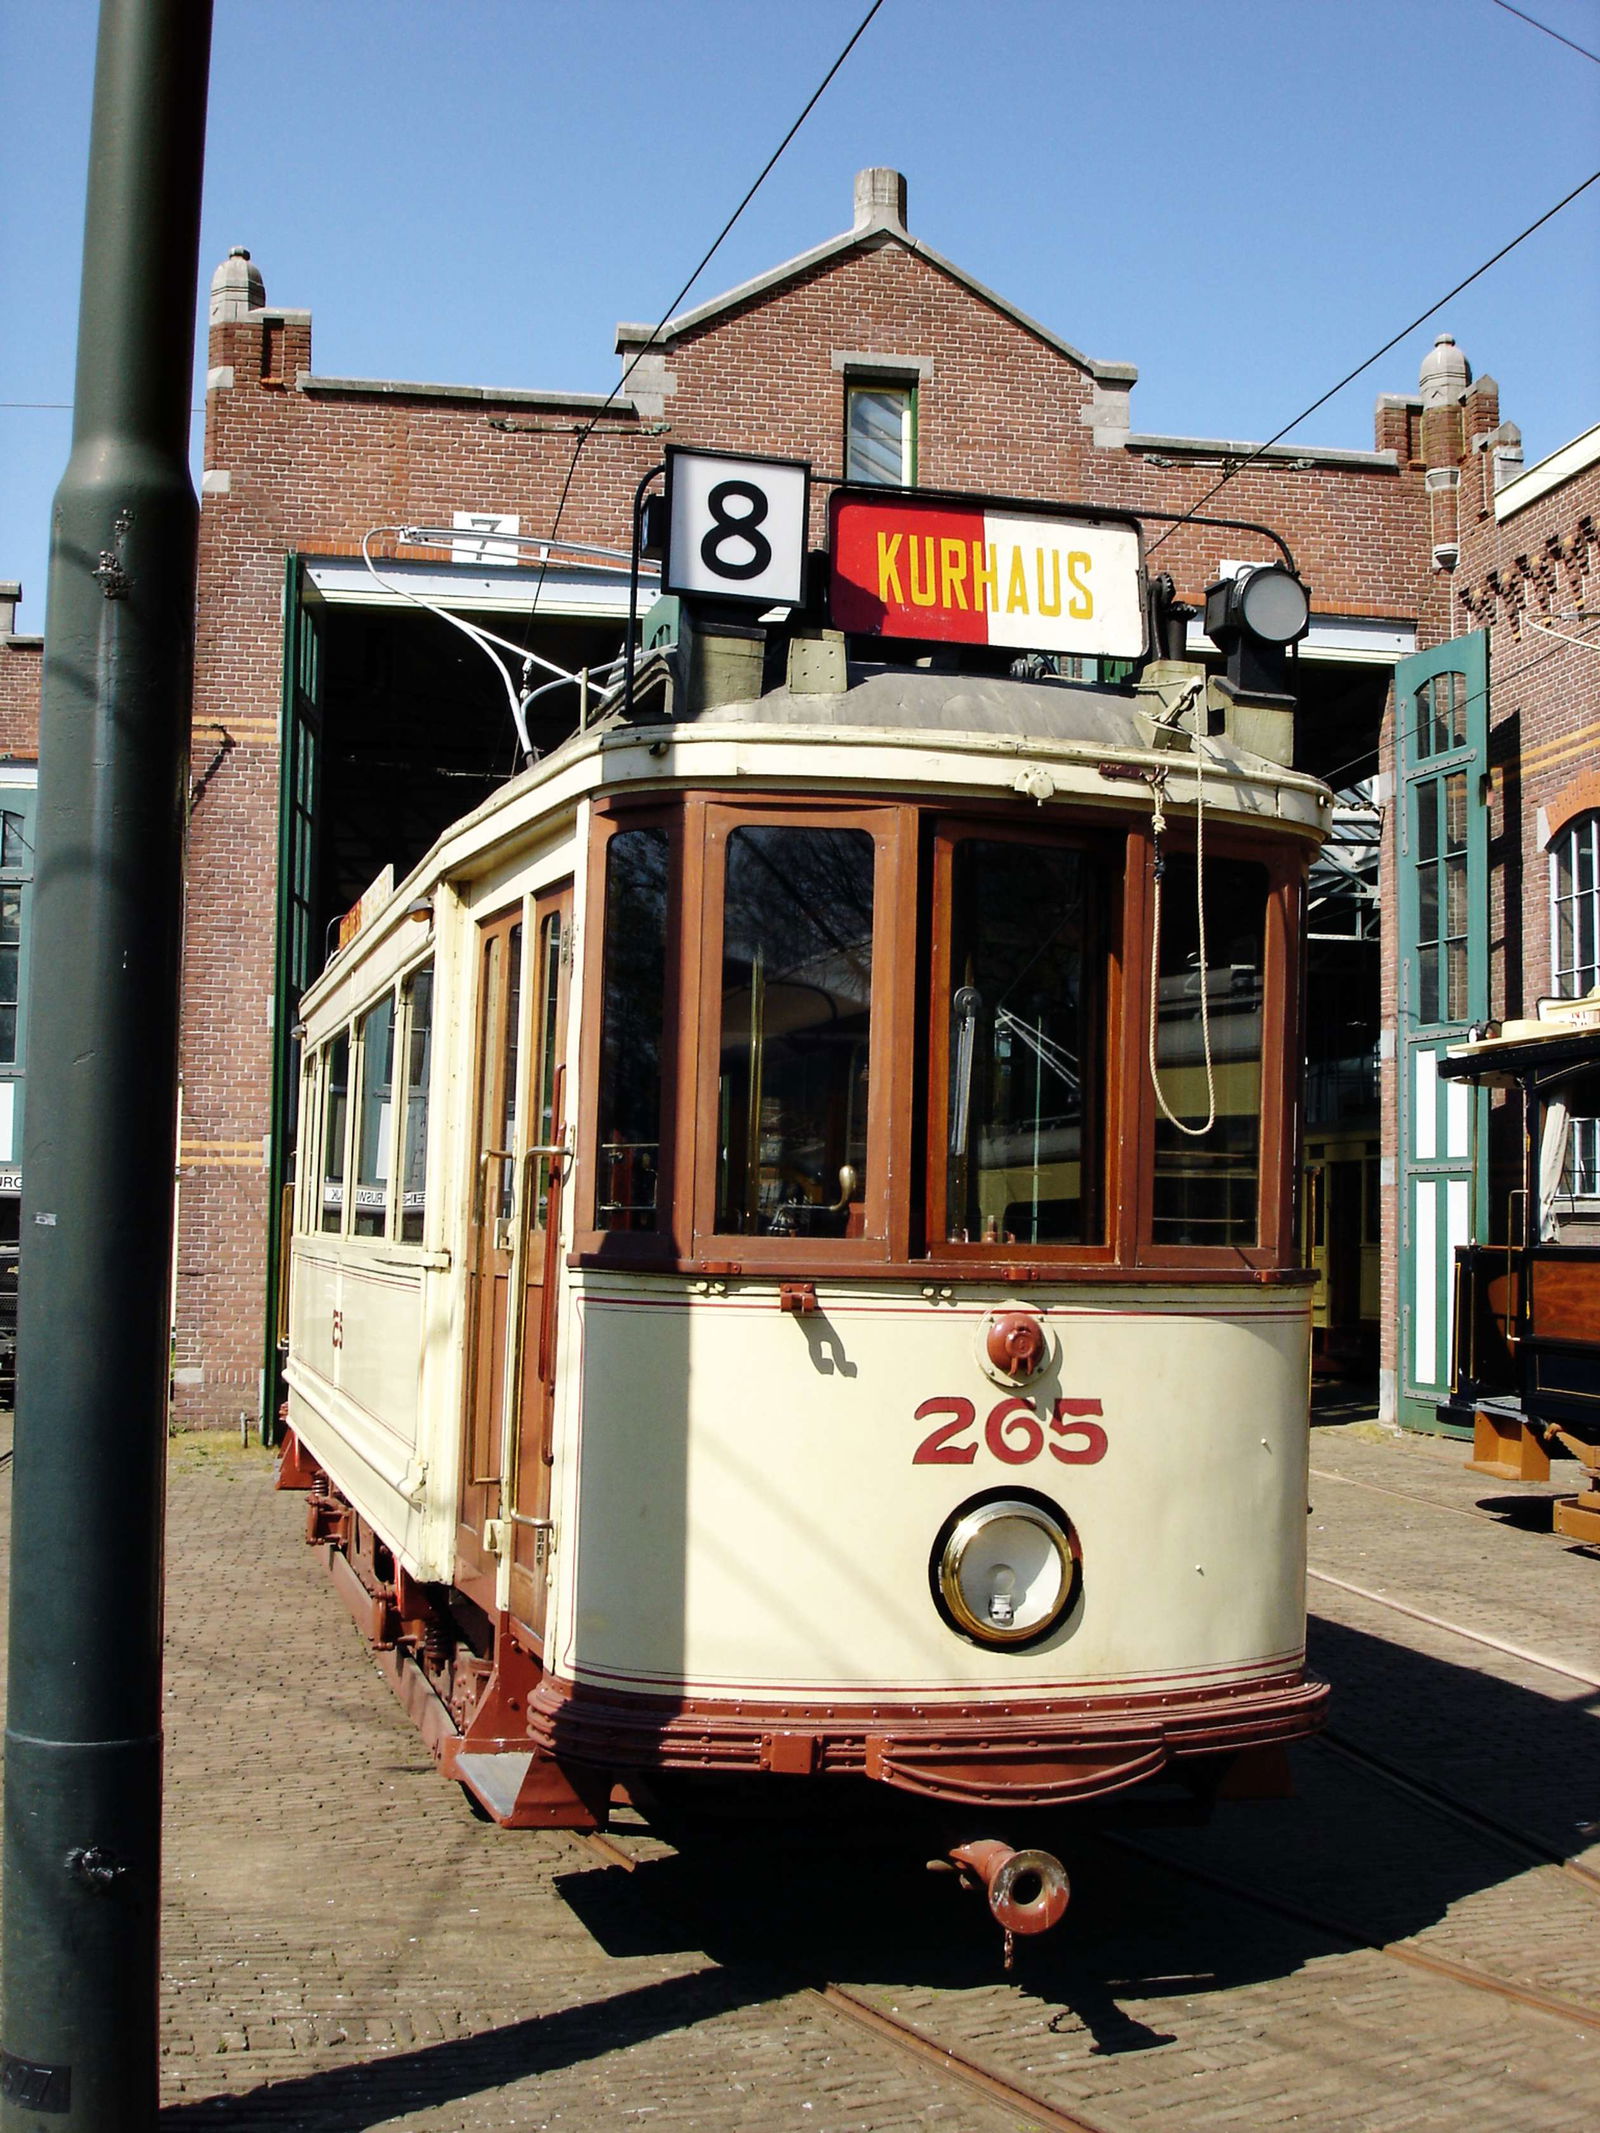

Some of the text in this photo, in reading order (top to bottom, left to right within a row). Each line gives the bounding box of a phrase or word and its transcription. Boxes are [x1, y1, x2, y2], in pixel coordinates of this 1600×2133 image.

[470, 518, 502, 561] 7
[700, 480, 772, 580] 8
[876, 531, 1094, 620] KURHAUS
[912, 1396, 1108, 1465] 265
